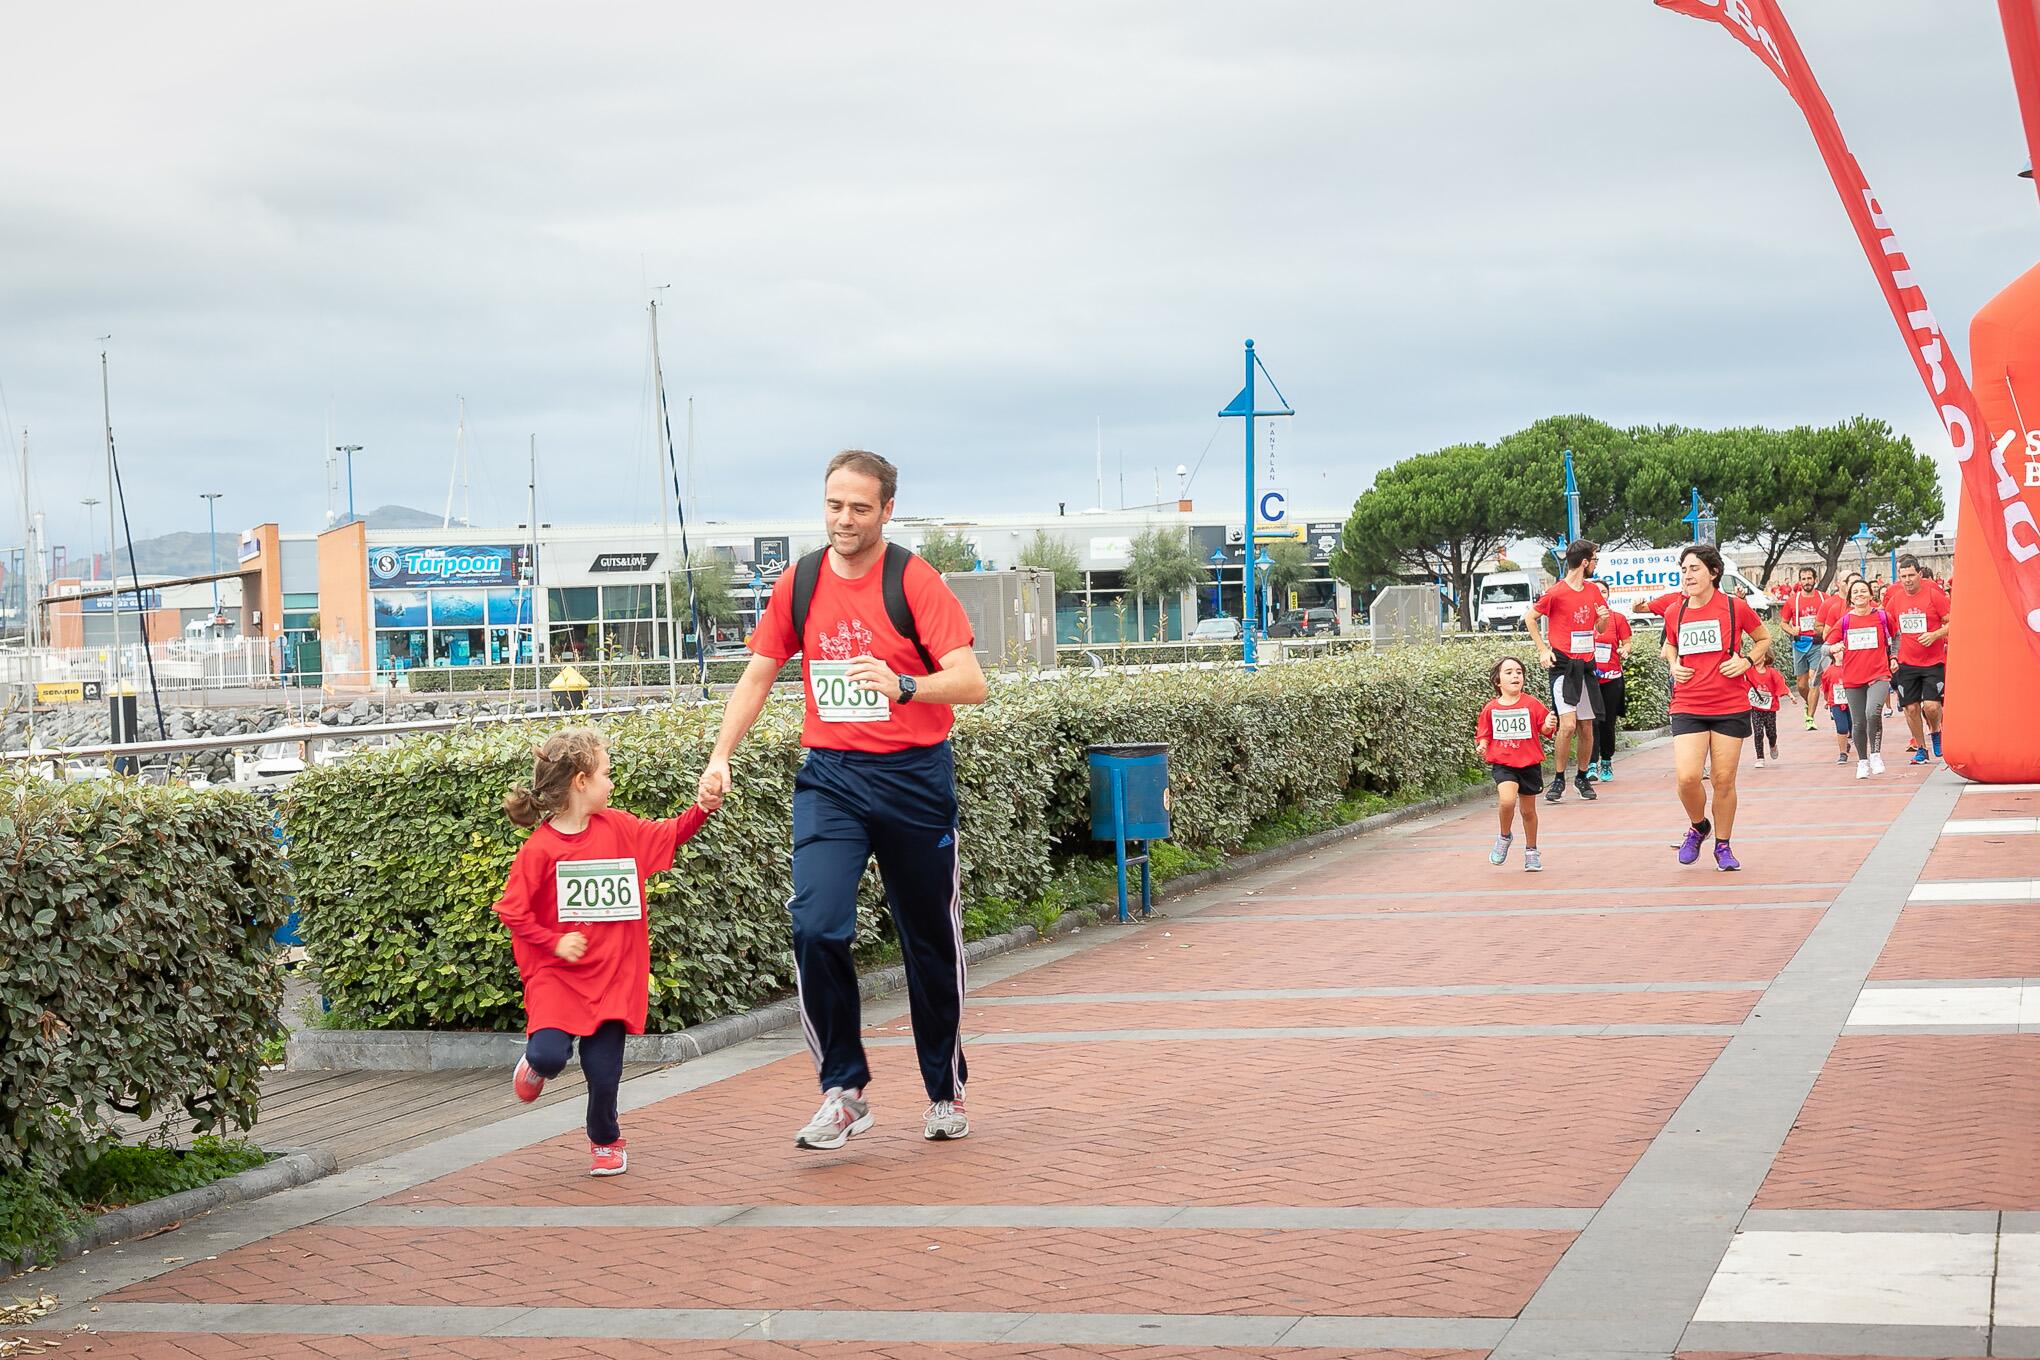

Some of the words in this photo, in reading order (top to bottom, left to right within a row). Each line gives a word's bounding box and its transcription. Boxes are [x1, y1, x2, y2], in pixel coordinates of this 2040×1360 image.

[1260, 492, 1285, 521] C
[405, 553, 502, 577] Tarpoon
[600, 557, 648, 567] GUTS&LOVE
[1610, 558, 1629, 566] 902
[1632, 557, 1645, 565] 88
[1647, 556, 1661, 564] 99
[1902, 619, 1923, 629] 2051
[1682, 629, 1717, 647] 2048
[816, 678, 879, 707] 2036
[1495, 717, 1527, 733] 2048
[566, 876, 632, 907] 2036
